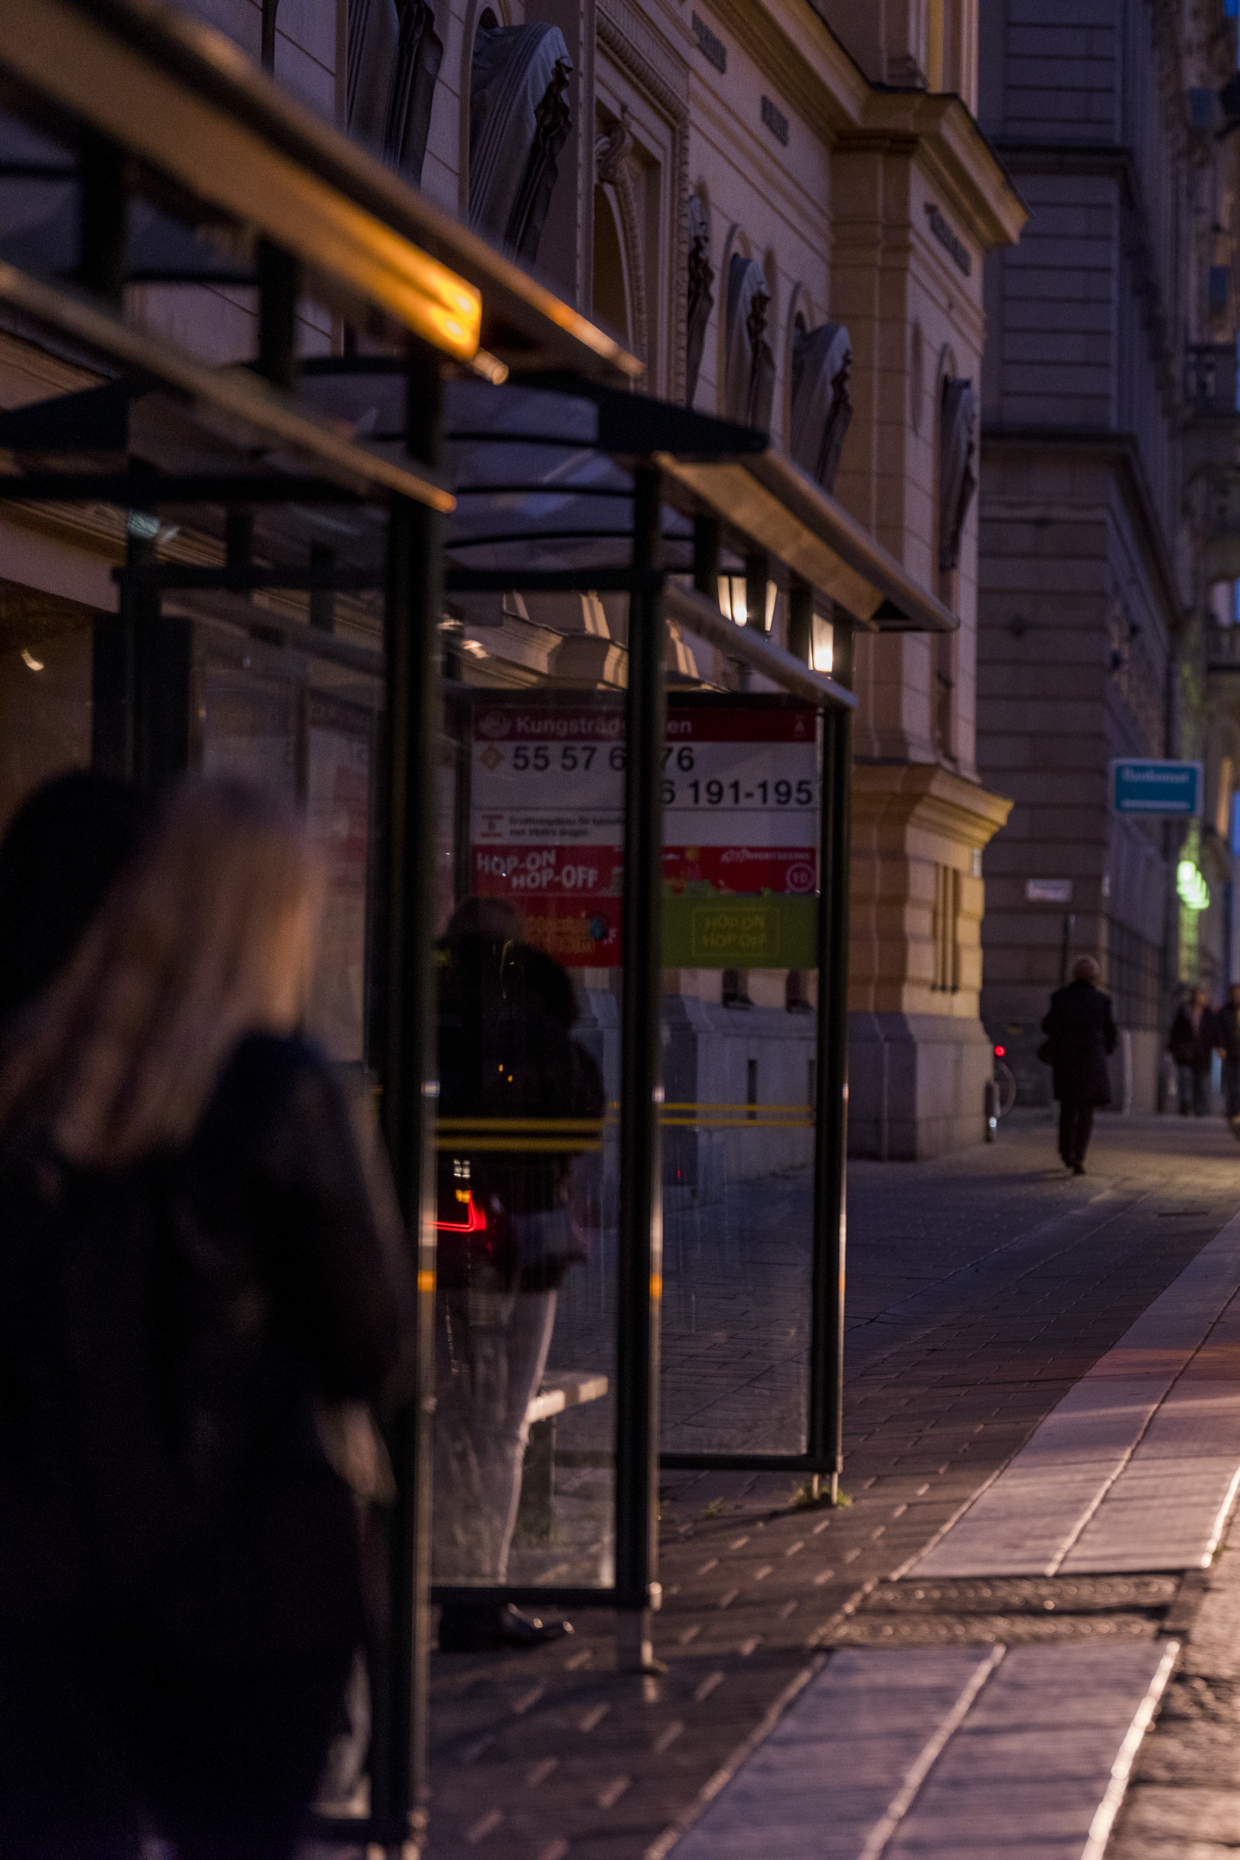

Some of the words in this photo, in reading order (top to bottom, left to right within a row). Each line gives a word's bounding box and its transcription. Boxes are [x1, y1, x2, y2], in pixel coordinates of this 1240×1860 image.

[515, 715, 693, 737] Kungsträden
[512, 746, 551, 772] 55
[561, 746, 597, 772] 57
[689, 779, 813, 806] 191-195
[511, 864, 599, 890] HOP-OFF
